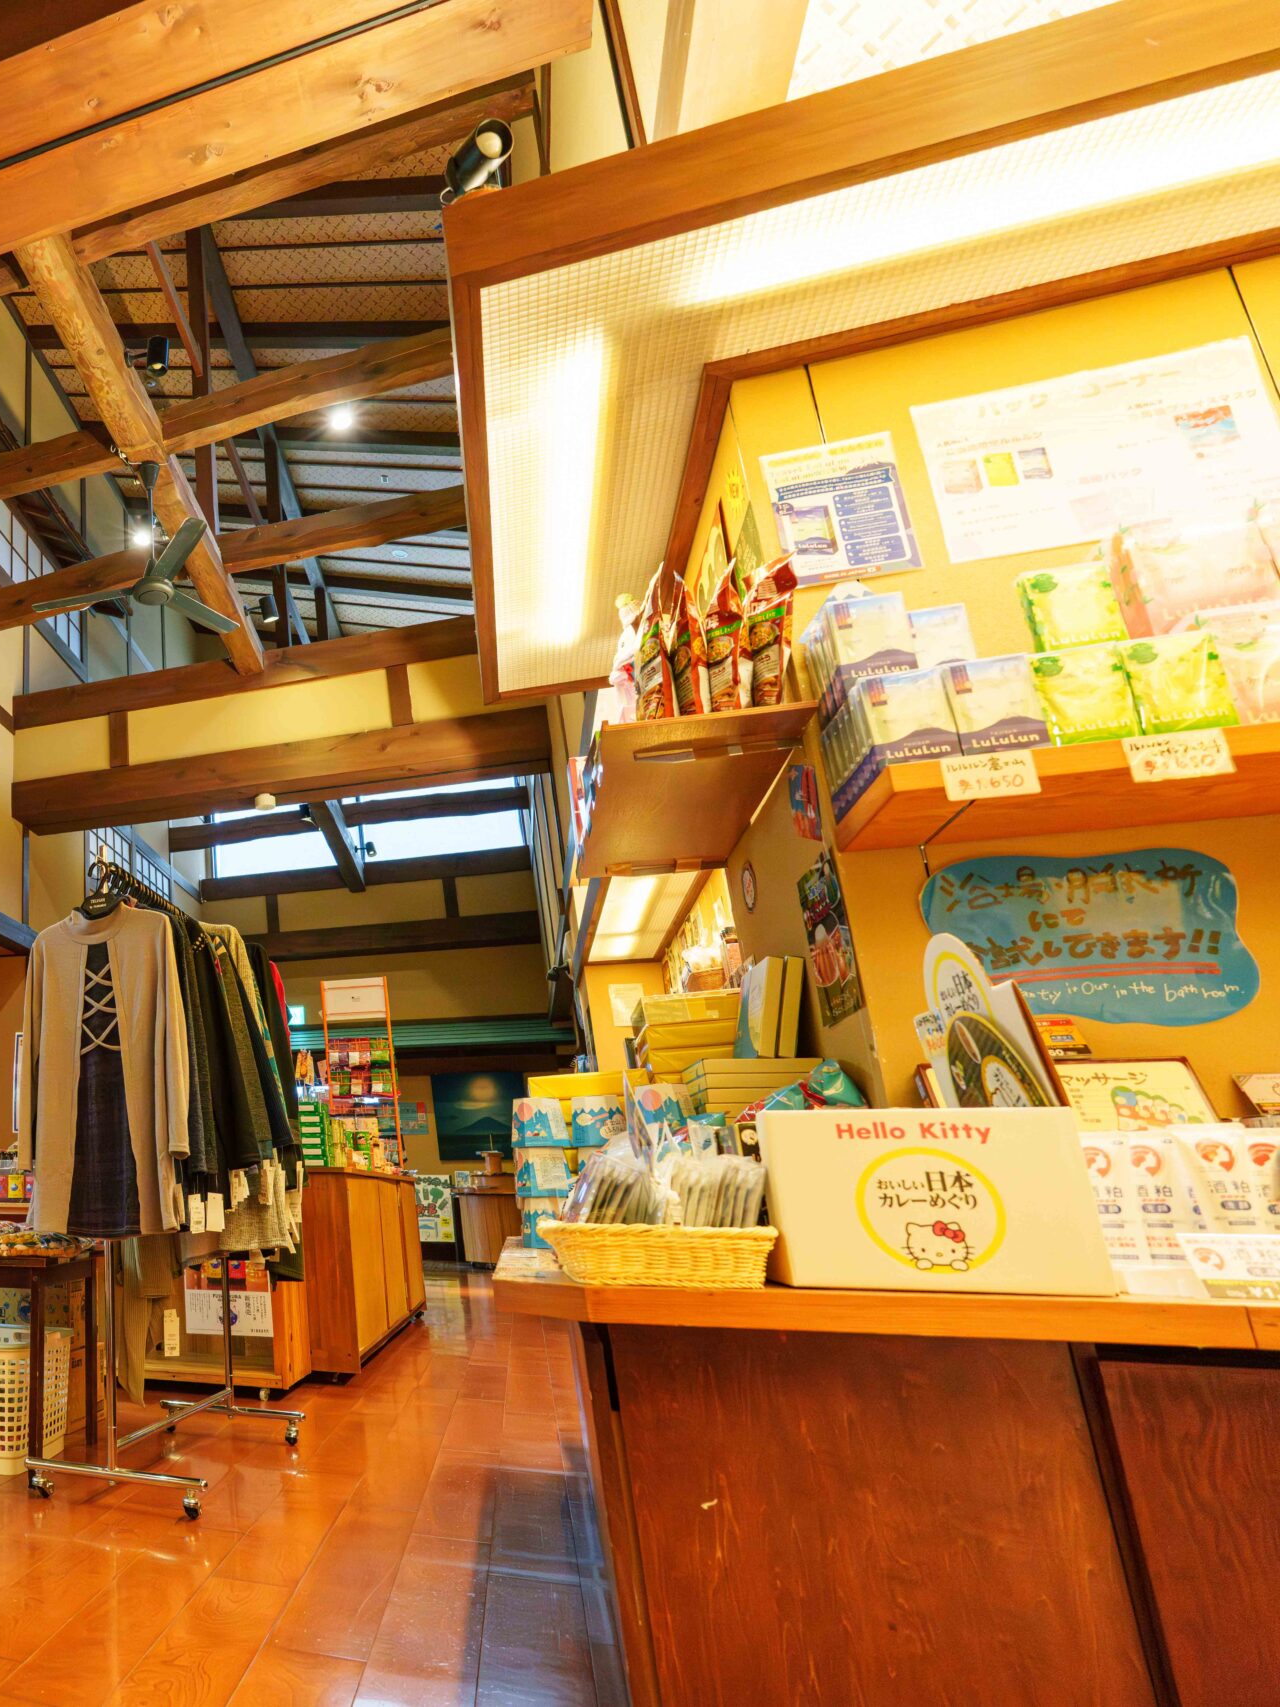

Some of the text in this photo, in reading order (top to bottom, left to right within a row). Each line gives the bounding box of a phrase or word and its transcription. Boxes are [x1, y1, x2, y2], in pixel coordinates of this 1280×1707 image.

[851, 664, 911, 679] LuLuLun
[971, 732, 1041, 749] LuLuLun
[886, 744, 952, 760] LuLuLun
[1028, 908, 1087, 932] にて
[1019, 987, 1037, 999] an
[1128, 981, 1156, 995] the
[1060, 1072, 1149, 1087] マッサージ
[835, 1122, 991, 1145] Hello Kitty
[876, 1170, 974, 1194] おいしい日本
[878, 1192, 979, 1211] カレーめぐり
